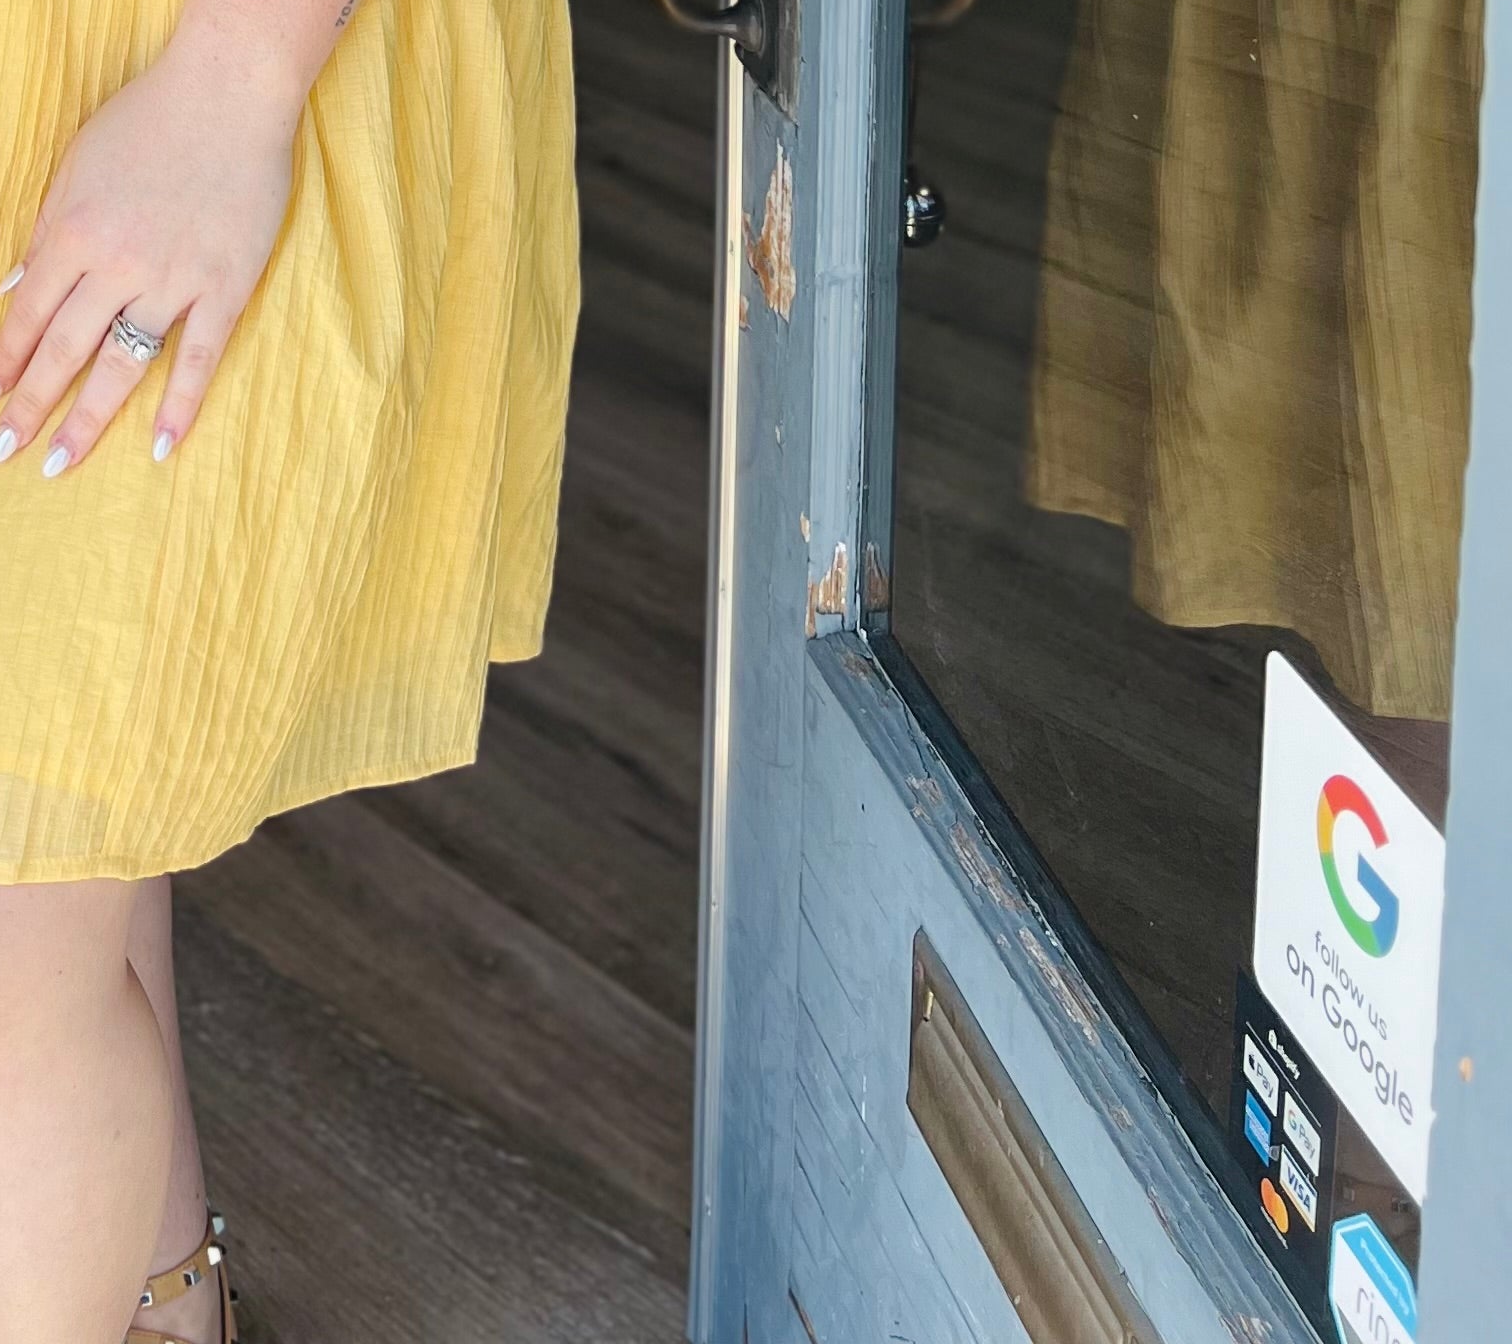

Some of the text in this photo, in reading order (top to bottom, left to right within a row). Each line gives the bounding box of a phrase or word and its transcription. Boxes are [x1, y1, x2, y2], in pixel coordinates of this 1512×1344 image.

[1314, 930, 1388, 1041] follow us
[1286, 944, 1414, 1126] on Google
[1256, 1063, 1274, 1099] Pay
[1287, 1165, 1311, 1212] VISA
[1356, 1287, 1402, 1344] rin
